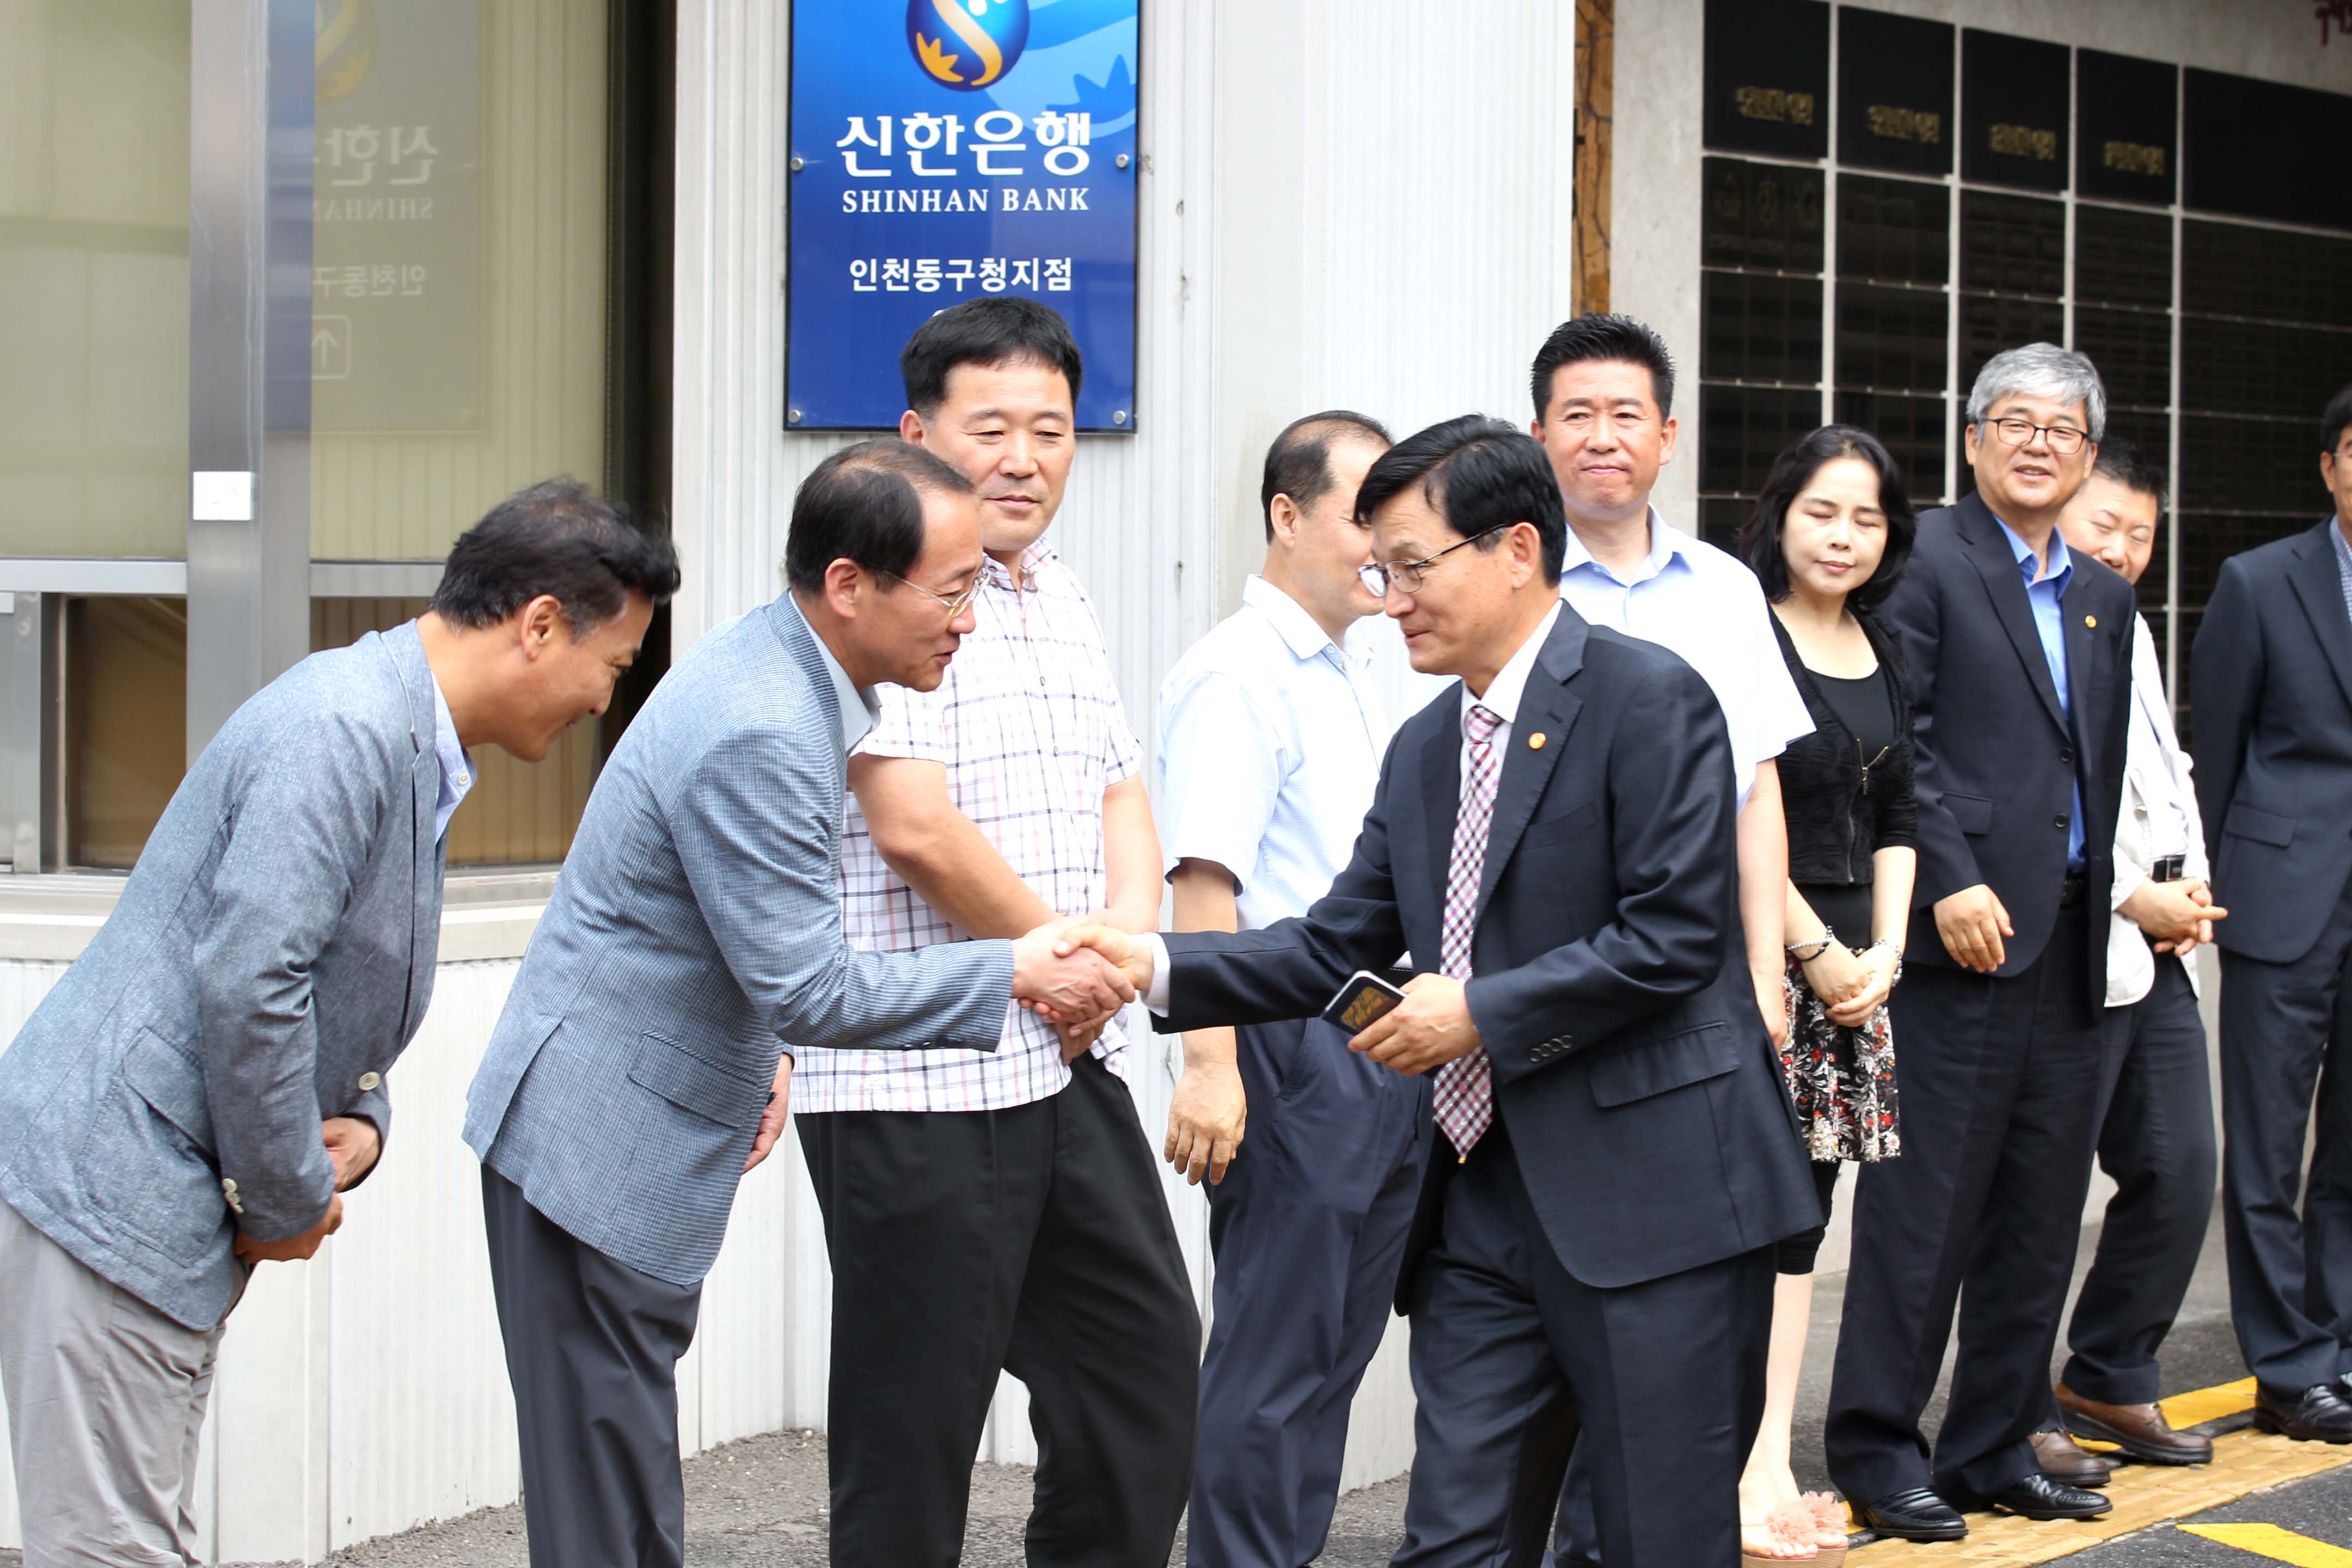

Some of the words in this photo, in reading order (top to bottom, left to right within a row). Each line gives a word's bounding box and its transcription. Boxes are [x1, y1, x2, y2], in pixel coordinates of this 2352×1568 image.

[836, 111, 1089, 176] 신한은행
[843, 189, 988, 212] SHINHAN
[1002, 188, 1089, 211] BANK
[850, 258, 1071, 292] 인천동구청지점
